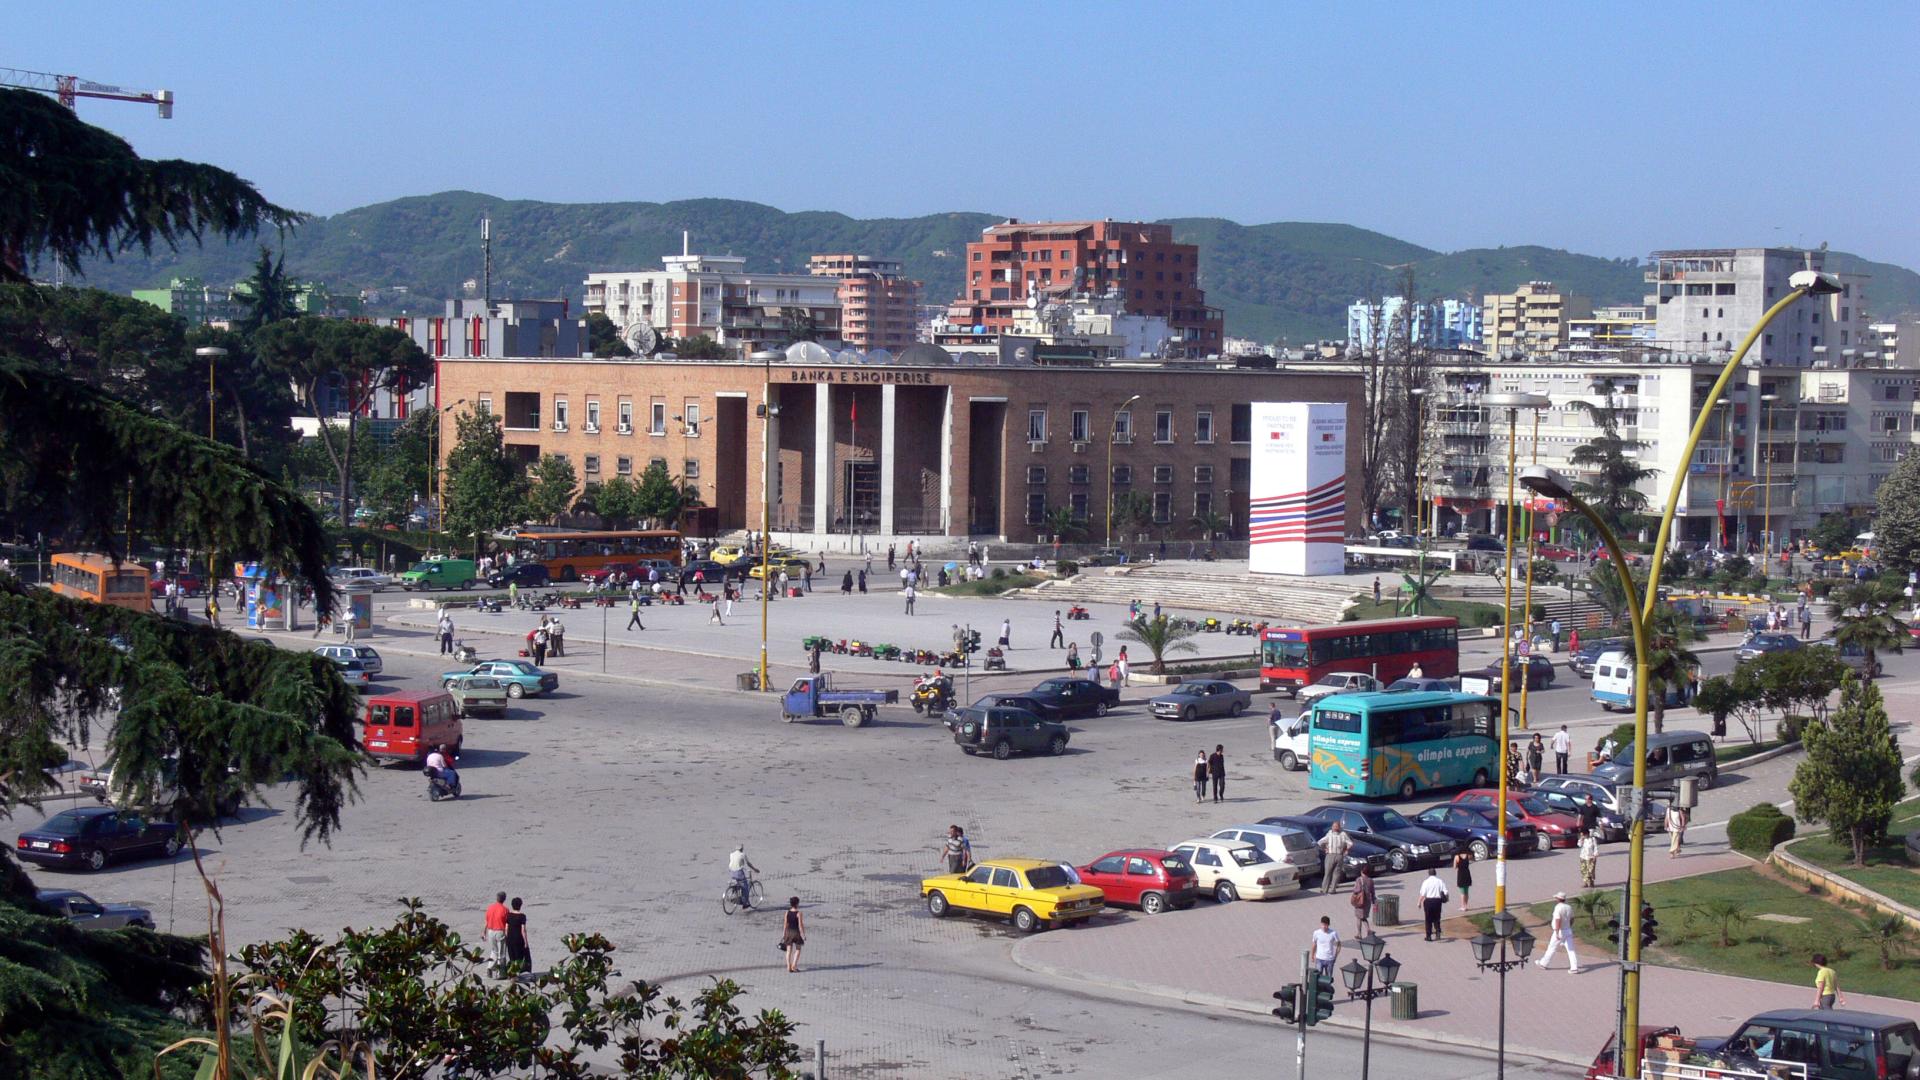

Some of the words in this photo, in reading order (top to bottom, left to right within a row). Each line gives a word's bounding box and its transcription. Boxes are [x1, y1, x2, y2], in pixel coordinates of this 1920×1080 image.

[791, 371, 834, 382] BANKA
[840, 371, 848, 382] E
[1312, 735, 1336, 744] olimpia
[1337, 738, 1361, 747] express
[1418, 747, 1453, 761] olimpia
[1456, 744, 1488, 759] express
